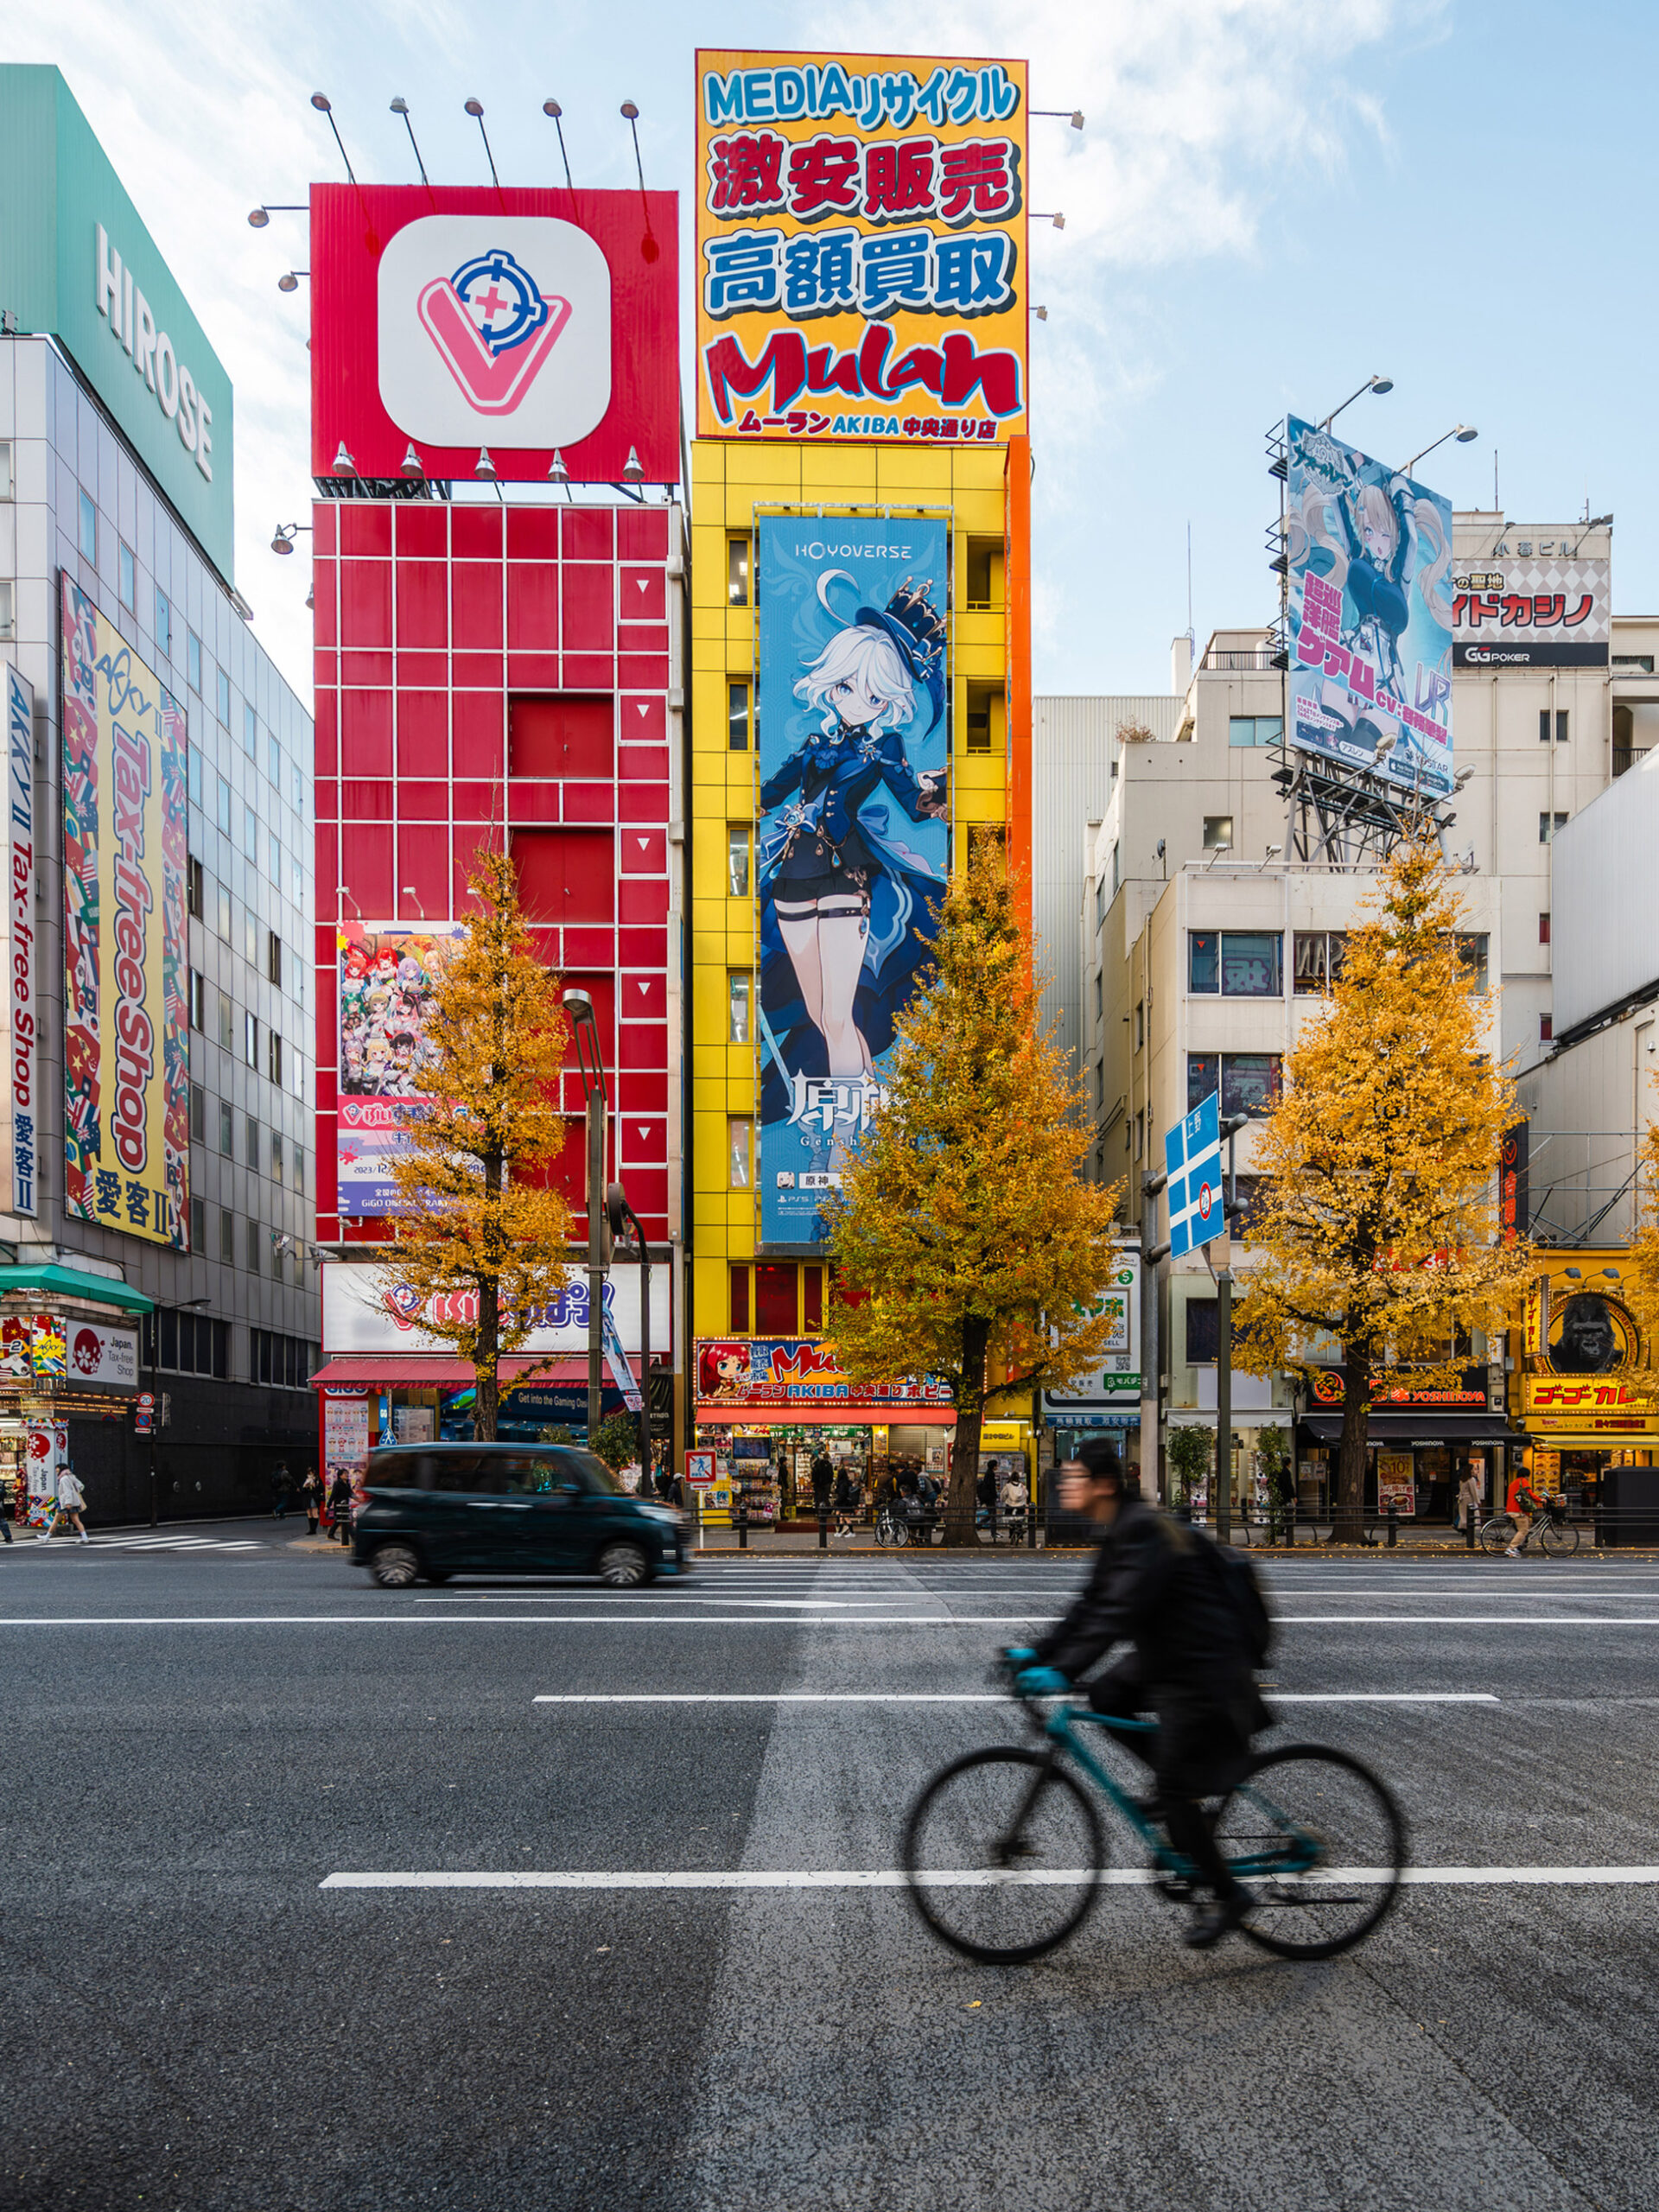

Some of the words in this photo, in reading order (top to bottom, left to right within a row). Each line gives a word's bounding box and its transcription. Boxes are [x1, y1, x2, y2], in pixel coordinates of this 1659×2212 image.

[709, 130, 1016, 224] 激安販売
[708, 230, 1011, 315] 高額買取
[96, 223, 213, 481] HIROSE
[704, 323, 1025, 423] Mulan
[795, 542, 912, 560] HOYOVERSE
[1452, 574, 1504, 590] の聖地
[1297, 624, 1375, 702] グアム
[12, 1007, 35, 1107] Shop
[111, 1002, 154, 1173] Shop
[805, 1175, 830, 1186] 原神
[108, 1350, 134, 1363] Tax-free
[118, 1364, 134, 1376] Shop
[141, 1395, 152, 1404] 20
[518, 1392, 530, 1404] Get
[531, 1393, 543, 1404] into
[543, 1395, 553, 1405] the
[554, 1396, 575, 1409] Gaming
